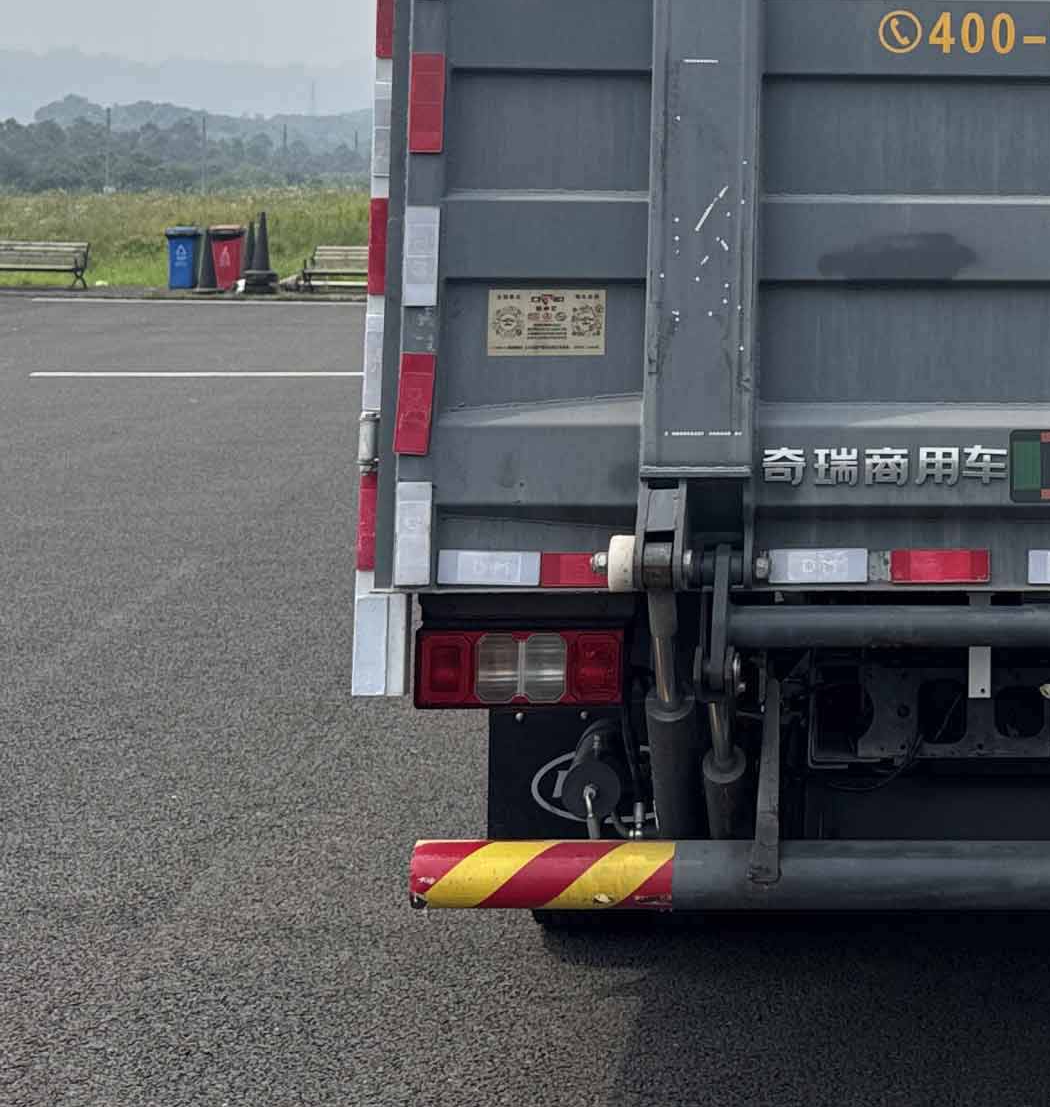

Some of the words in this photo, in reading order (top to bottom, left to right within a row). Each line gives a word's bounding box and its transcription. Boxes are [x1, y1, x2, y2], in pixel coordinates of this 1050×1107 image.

[761, 444, 1008, 486] 奇瑞商用车
